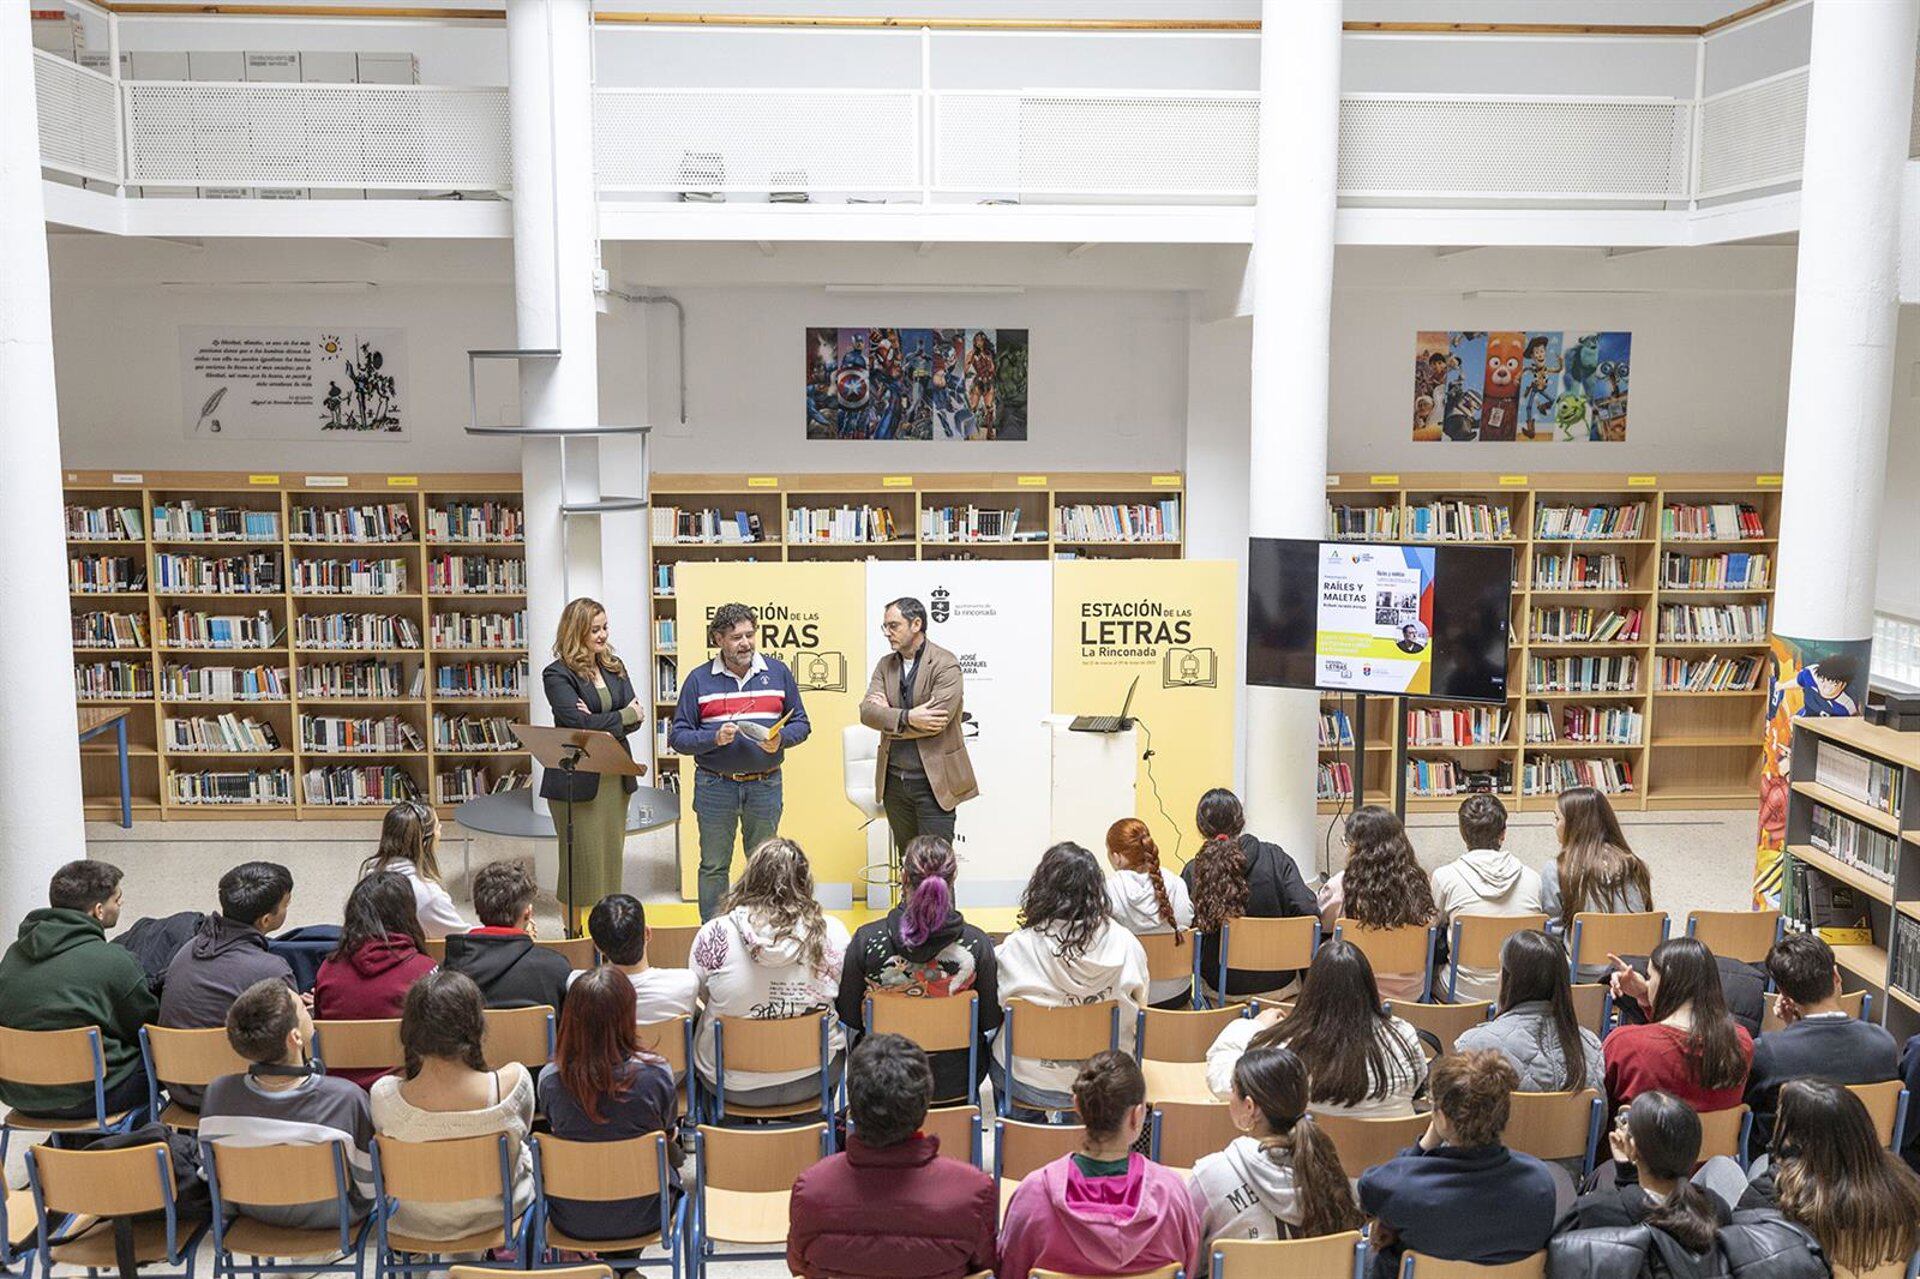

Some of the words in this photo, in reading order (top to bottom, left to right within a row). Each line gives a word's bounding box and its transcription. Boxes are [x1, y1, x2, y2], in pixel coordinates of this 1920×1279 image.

[1323, 580, 1355, 592] RAÍLES
[1358, 583, 1364, 592] Y
[1323, 593, 1367, 603] MALETAS
[706, 602, 788, 620] ECIÓN
[790, 612, 802, 620] DE
[1081, 599, 1162, 617] ESTACIÓN
[1163, 609, 1174, 617] DE
[1176, 609, 1192, 617] LAS
[706, 624, 819, 648] LRAS
[1081, 620, 1191, 644] LETRAS
[1082, 647, 1095, 657] La
[1099, 646, 1157, 657] Rinconada
